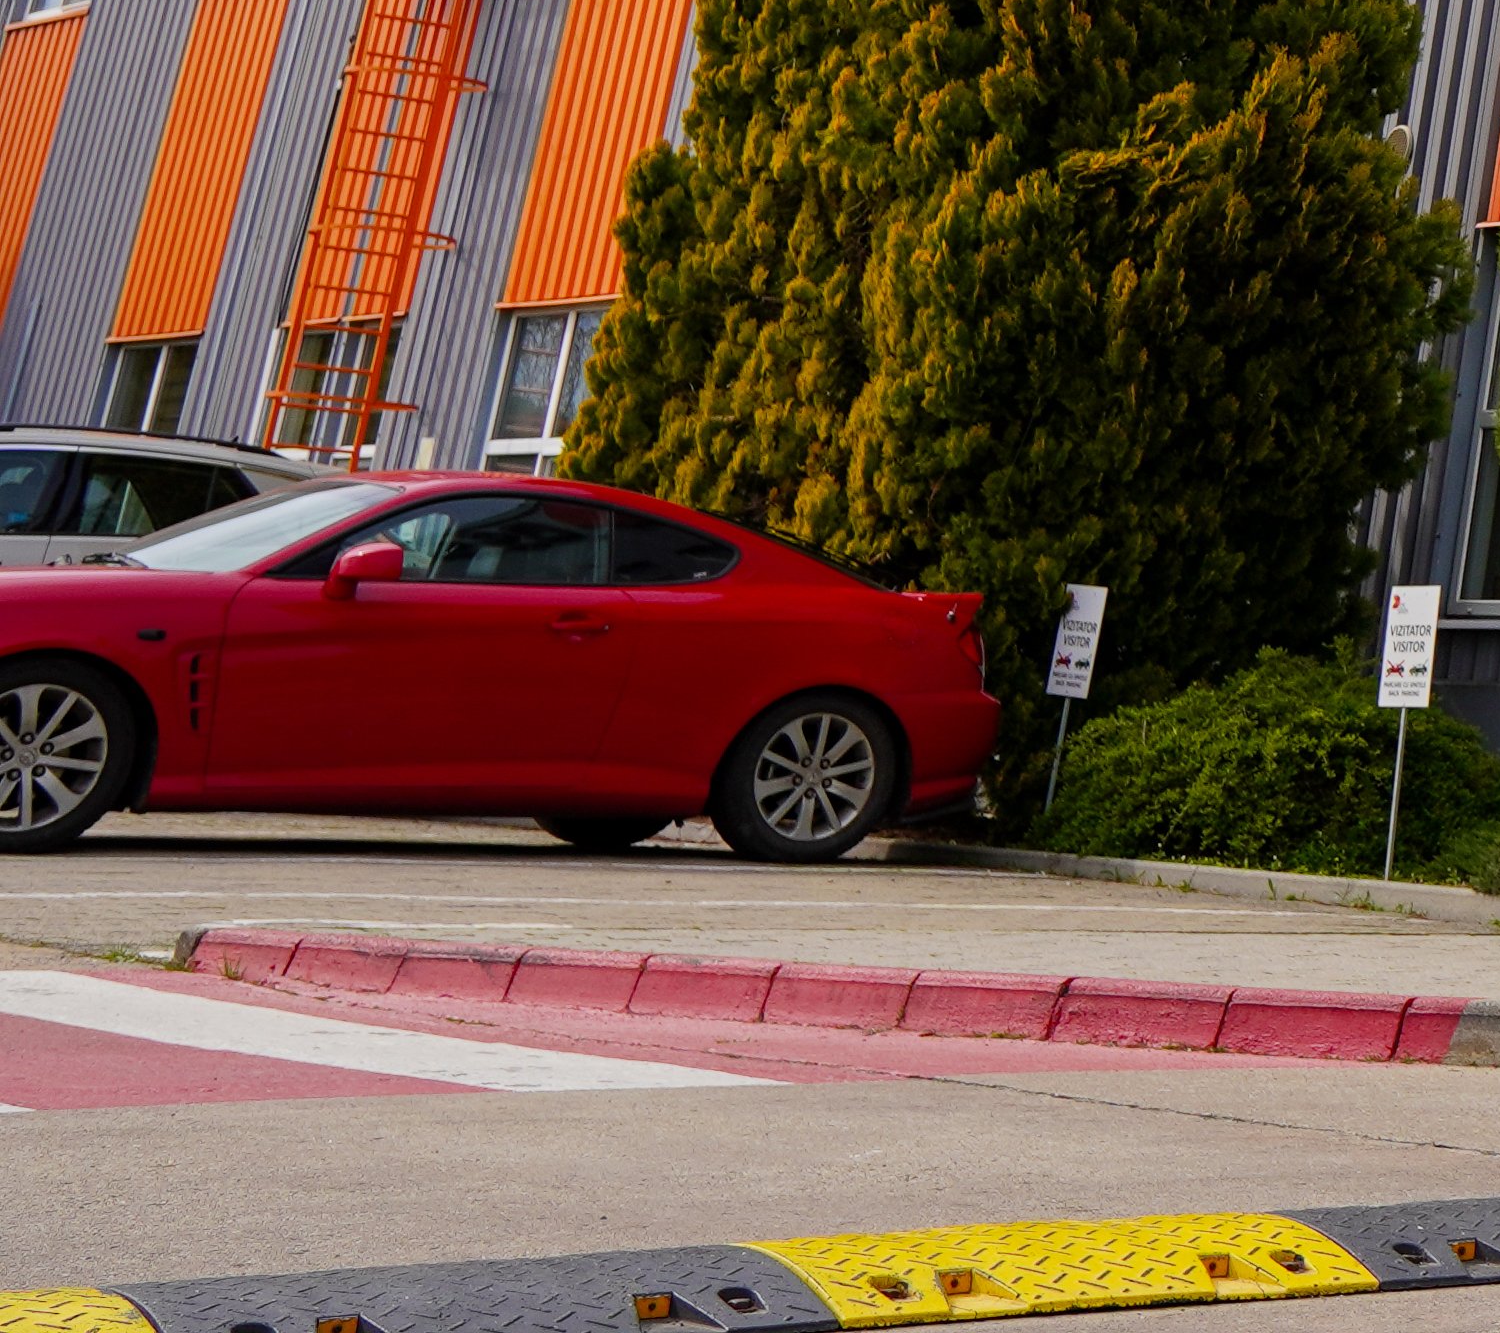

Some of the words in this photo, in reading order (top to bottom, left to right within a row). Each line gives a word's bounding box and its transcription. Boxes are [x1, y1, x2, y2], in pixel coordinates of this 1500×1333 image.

[1390, 624, 1432, 637] VIZITATOR
[1063, 633, 1092, 649] VISITOR
[1393, 641, 1426, 653] VISITOR
